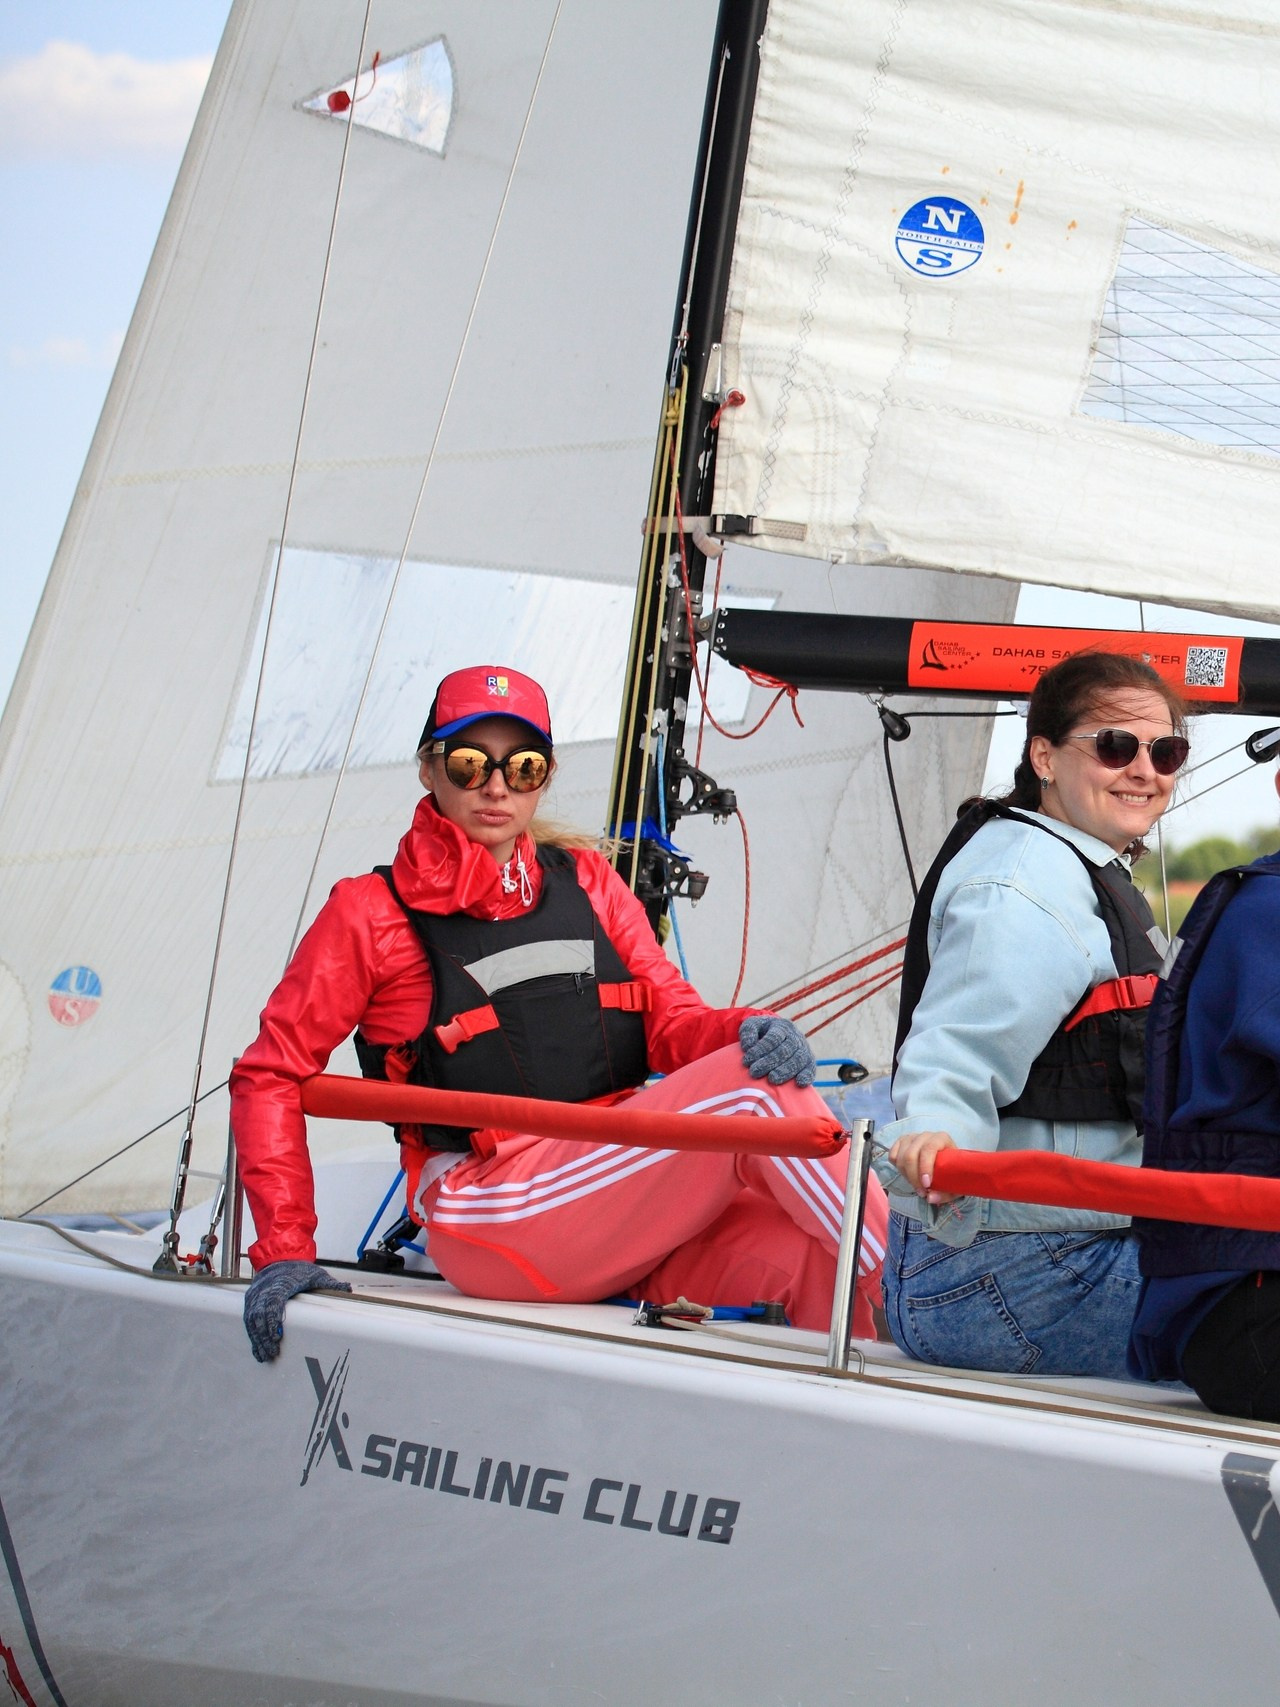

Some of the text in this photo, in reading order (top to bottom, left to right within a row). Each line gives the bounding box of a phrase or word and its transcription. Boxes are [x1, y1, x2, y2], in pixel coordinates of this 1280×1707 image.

[896, 230, 984, 250] NORTH SAILS
[992, 647, 1045, 658] DAHAB
[360, 1433, 570, 1515] SAILING
[582, 1477, 741, 1545] CLUB
